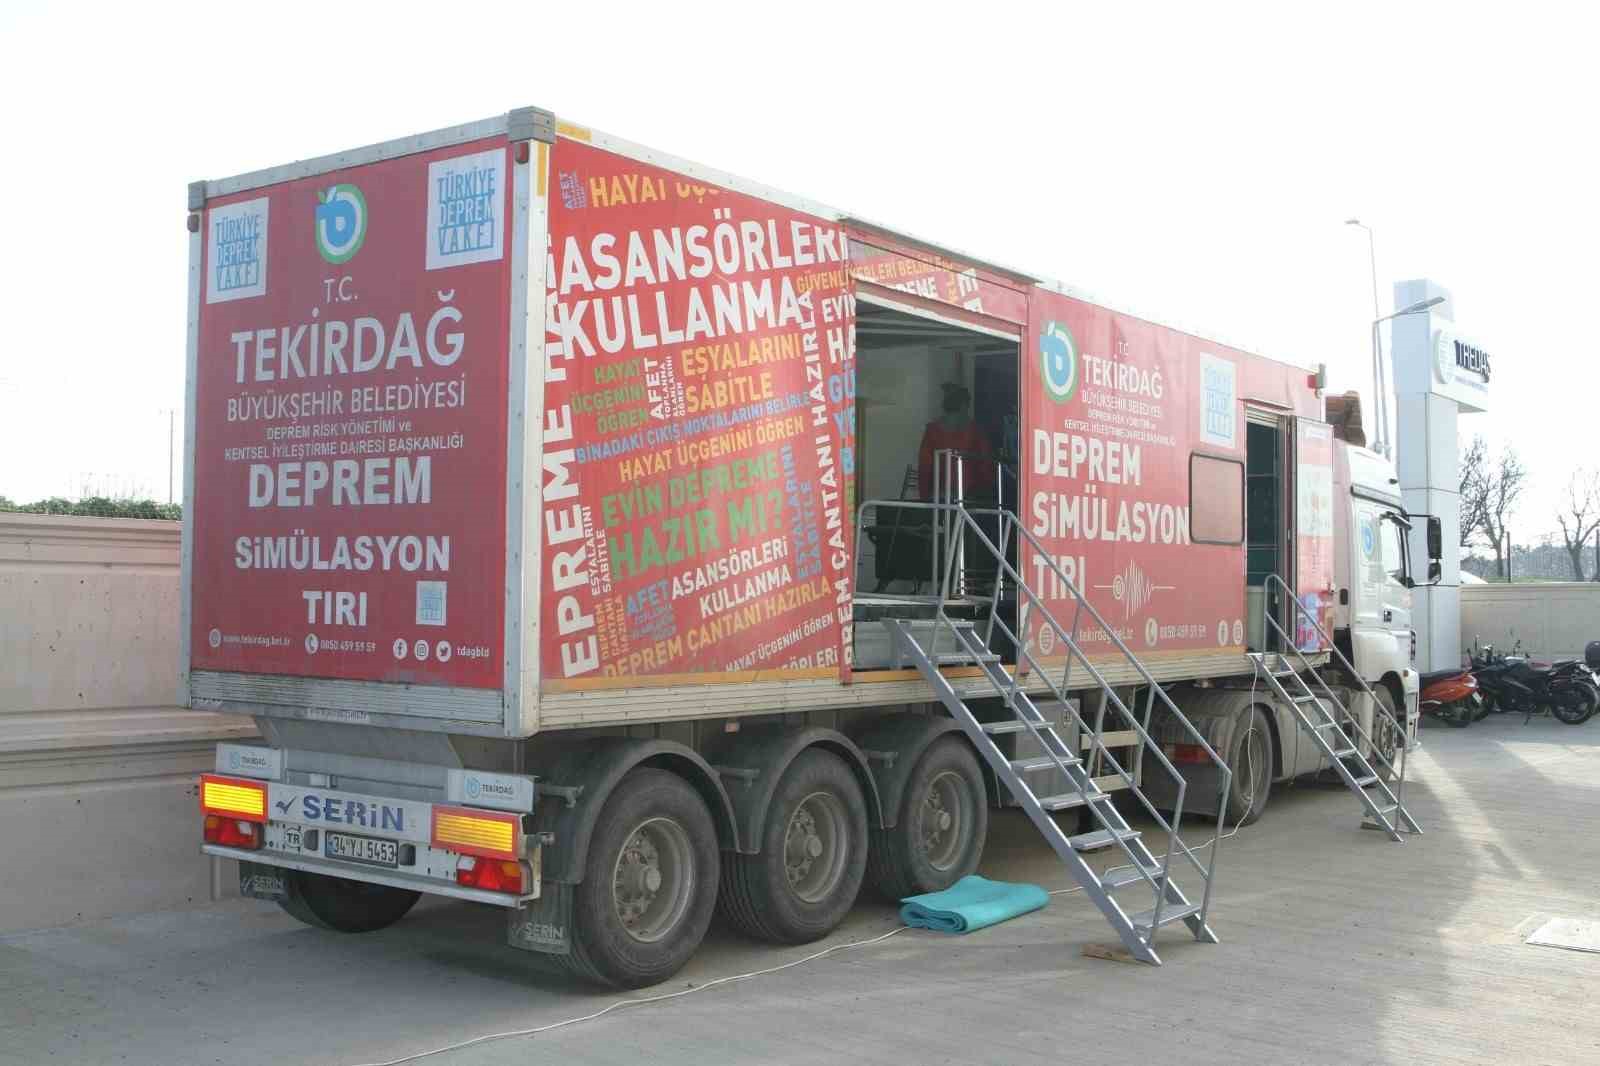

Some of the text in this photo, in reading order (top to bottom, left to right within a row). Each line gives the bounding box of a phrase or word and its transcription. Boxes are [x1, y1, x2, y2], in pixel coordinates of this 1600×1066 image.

[438, 166, 495, 203] TÜRKİYE
[323, 276, 358, 304] T.C.
[558, 275, 804, 360] KULLANMA
[232, 289, 465, 384] TEKİRDAĞ
[797, 290, 829, 427] HAZIRLA
[227, 374, 465, 424] BÜYÜKŞEHİR BELEDİYESİ
[644, 357, 664, 420] AFET
[686, 371, 774, 412] SABİTLE
[1082, 353, 1162, 400] TEKİRDAĞ
[267, 422, 311, 441] DEPREM
[398, 421, 412, 432] ve
[619, 449, 673, 482] HAYAT
[678, 428, 752, 467] ÜÇGENİNİ
[756, 416, 805, 445] ÖĞREN
[1033, 429, 1141, 487] DEPREM
[248, 456, 432, 508] DEPREM
[602, 478, 663, 528] EVİN
[669, 452, 780, 509] DEPREME
[815, 433, 851, 571] ÇANTANI
[543, 404, 600, 678] EPREME
[610, 508, 722, 582] HAZIR
[727, 490, 783, 544] MI?
[700, 563, 793, 619] KULLANMA
[1033, 555, 1087, 600] TIRI
[303, 591, 367, 626] TIRI
[687, 604, 763, 656] ÇANTANI
[766, 576, 832, 619] HAZIRLA
[286, 832, 300, 845] TR
[333, 836, 395, 862] 34 YJ 5453
